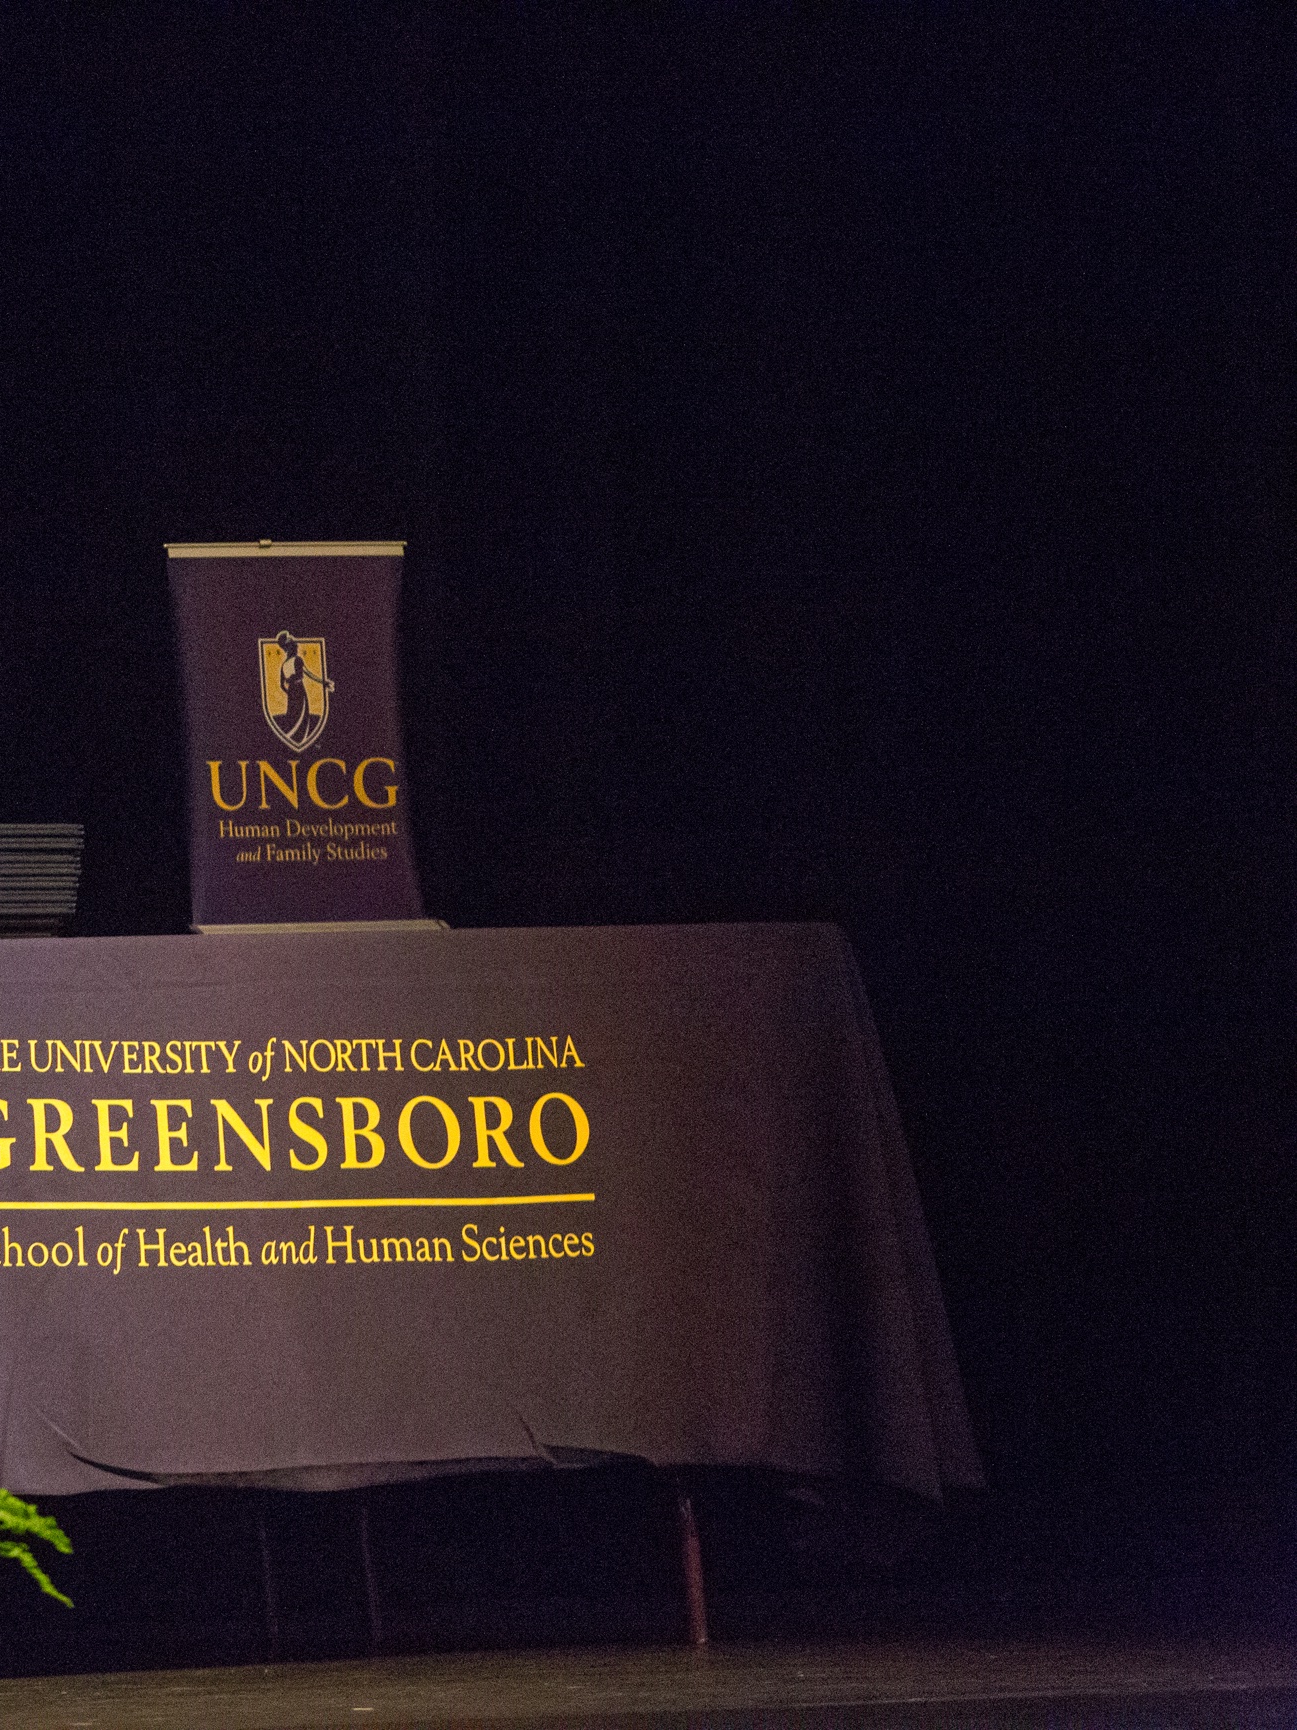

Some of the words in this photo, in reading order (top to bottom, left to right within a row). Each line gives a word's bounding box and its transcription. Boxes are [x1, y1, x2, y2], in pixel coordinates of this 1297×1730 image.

[207, 757, 399, 812] UNCG
[218, 819, 281, 838] Human
[286, 817, 398, 841] Development
[236, 846, 262, 863] and
[266, 842, 321, 865] Family
[326, 841, 388, 862] Studies
[28, 1038, 242, 1075] UNIVERSITY
[247, 1036, 278, 1082] of
[282, 1037, 405, 1074] NORTH
[409, 1034, 586, 1074] CAROLINA
[96, 1227, 130, 1276] of
[136, 1225, 253, 1268] Health
[259, 1224, 317, 1266] and
[323, 1224, 456, 1265] Human
[461, 1222, 596, 1264] Sciences
